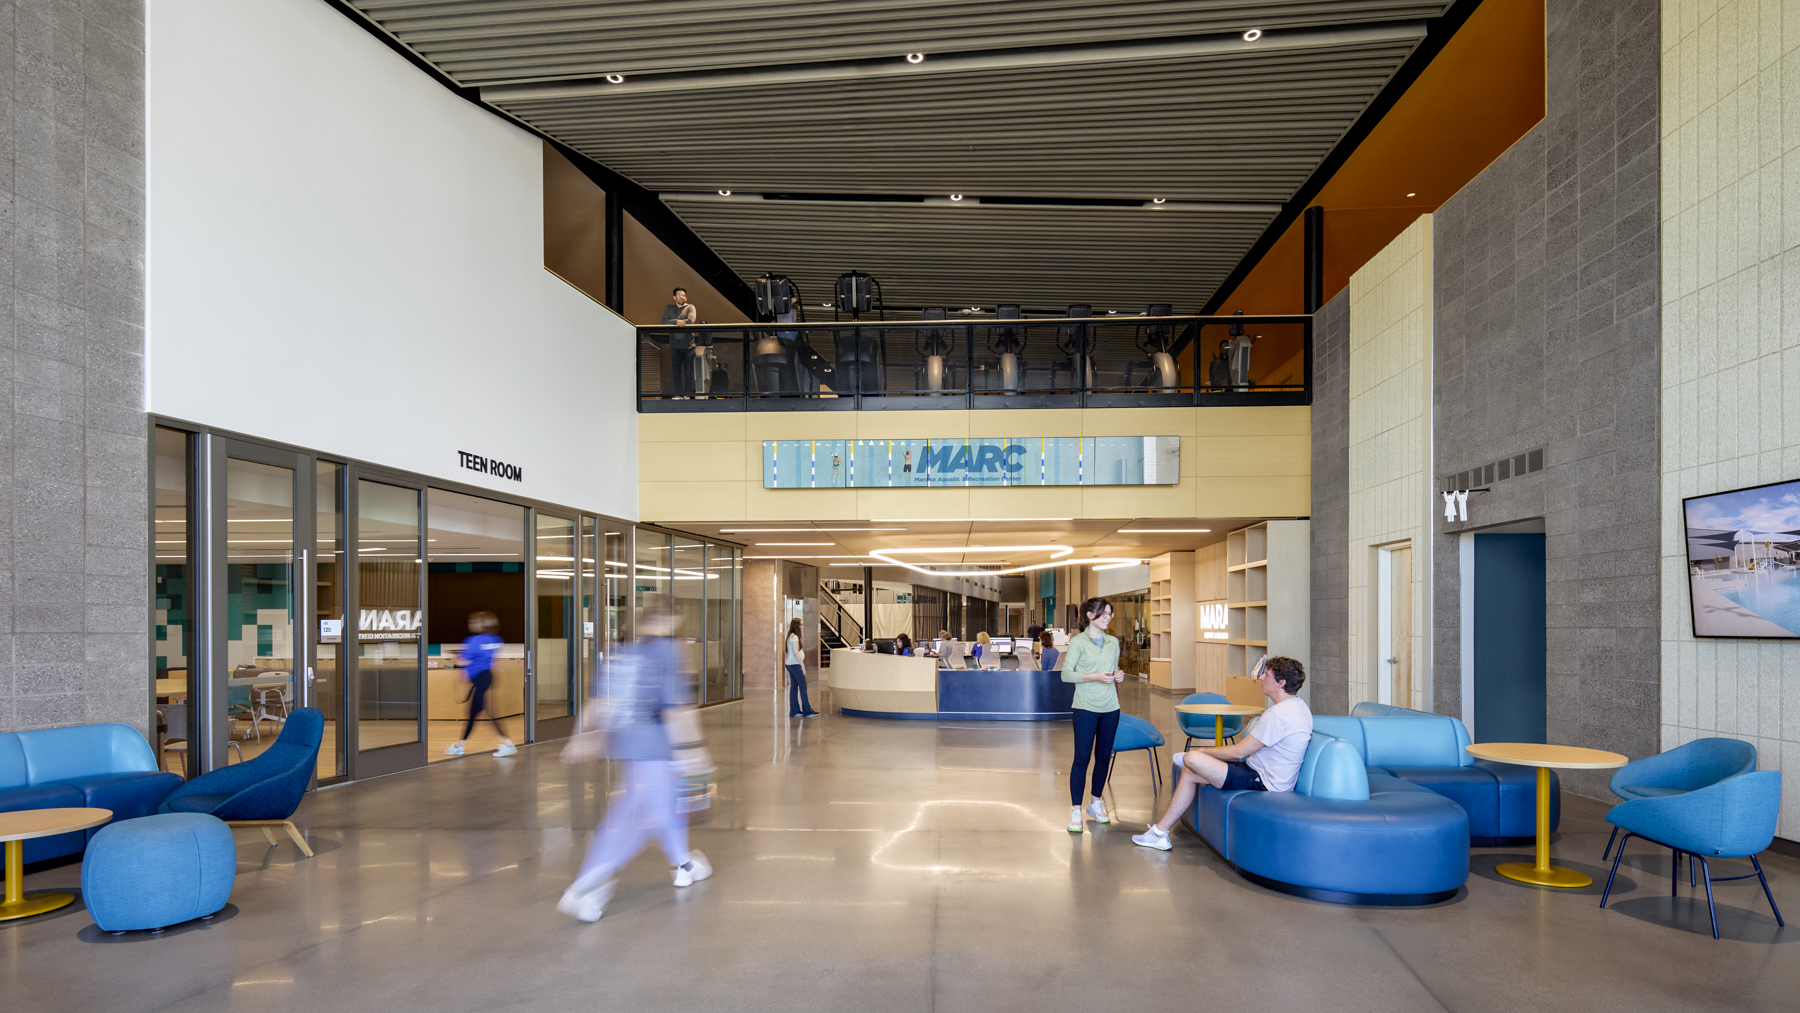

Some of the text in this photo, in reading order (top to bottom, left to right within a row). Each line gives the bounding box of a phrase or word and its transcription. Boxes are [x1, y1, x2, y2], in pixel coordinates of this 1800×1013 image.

[458, 450, 522, 482] TEEN ROOM
[916, 444, 1027, 473] MARC
